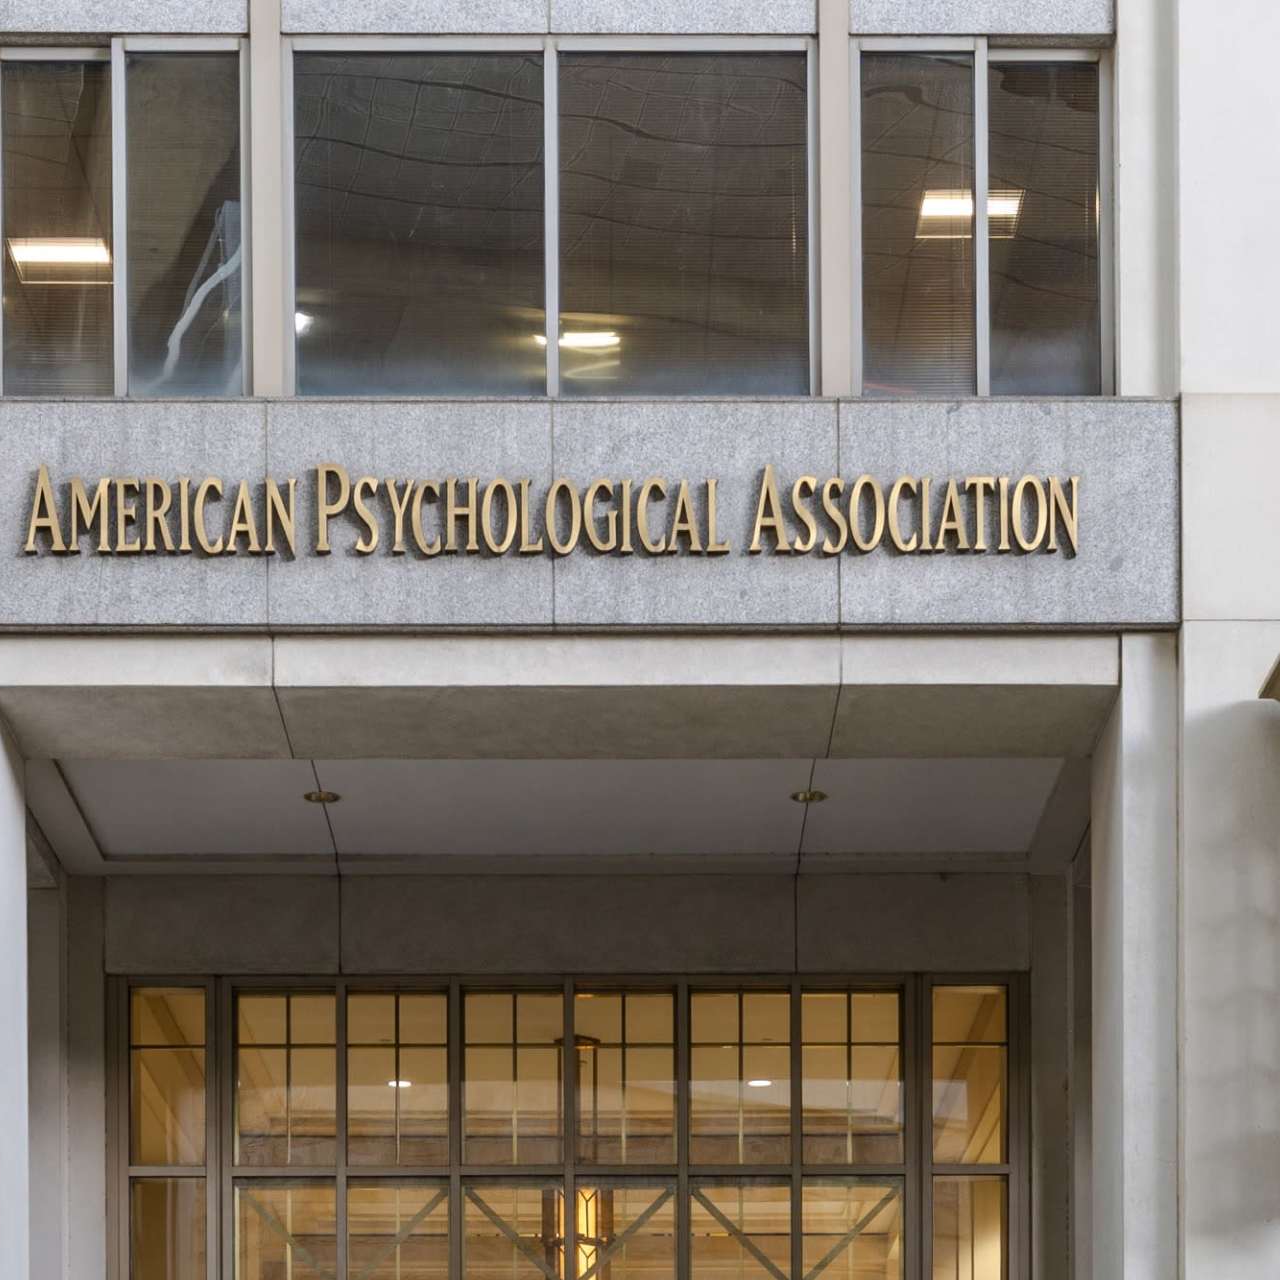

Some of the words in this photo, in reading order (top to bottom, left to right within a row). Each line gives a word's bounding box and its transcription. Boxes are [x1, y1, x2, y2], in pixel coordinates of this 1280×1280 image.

[25, 465, 296, 558] AMERICAN
[315, 462, 728, 557] PSYCHOLOGICAL
[750, 464, 1081, 558] ASSOCIATION
